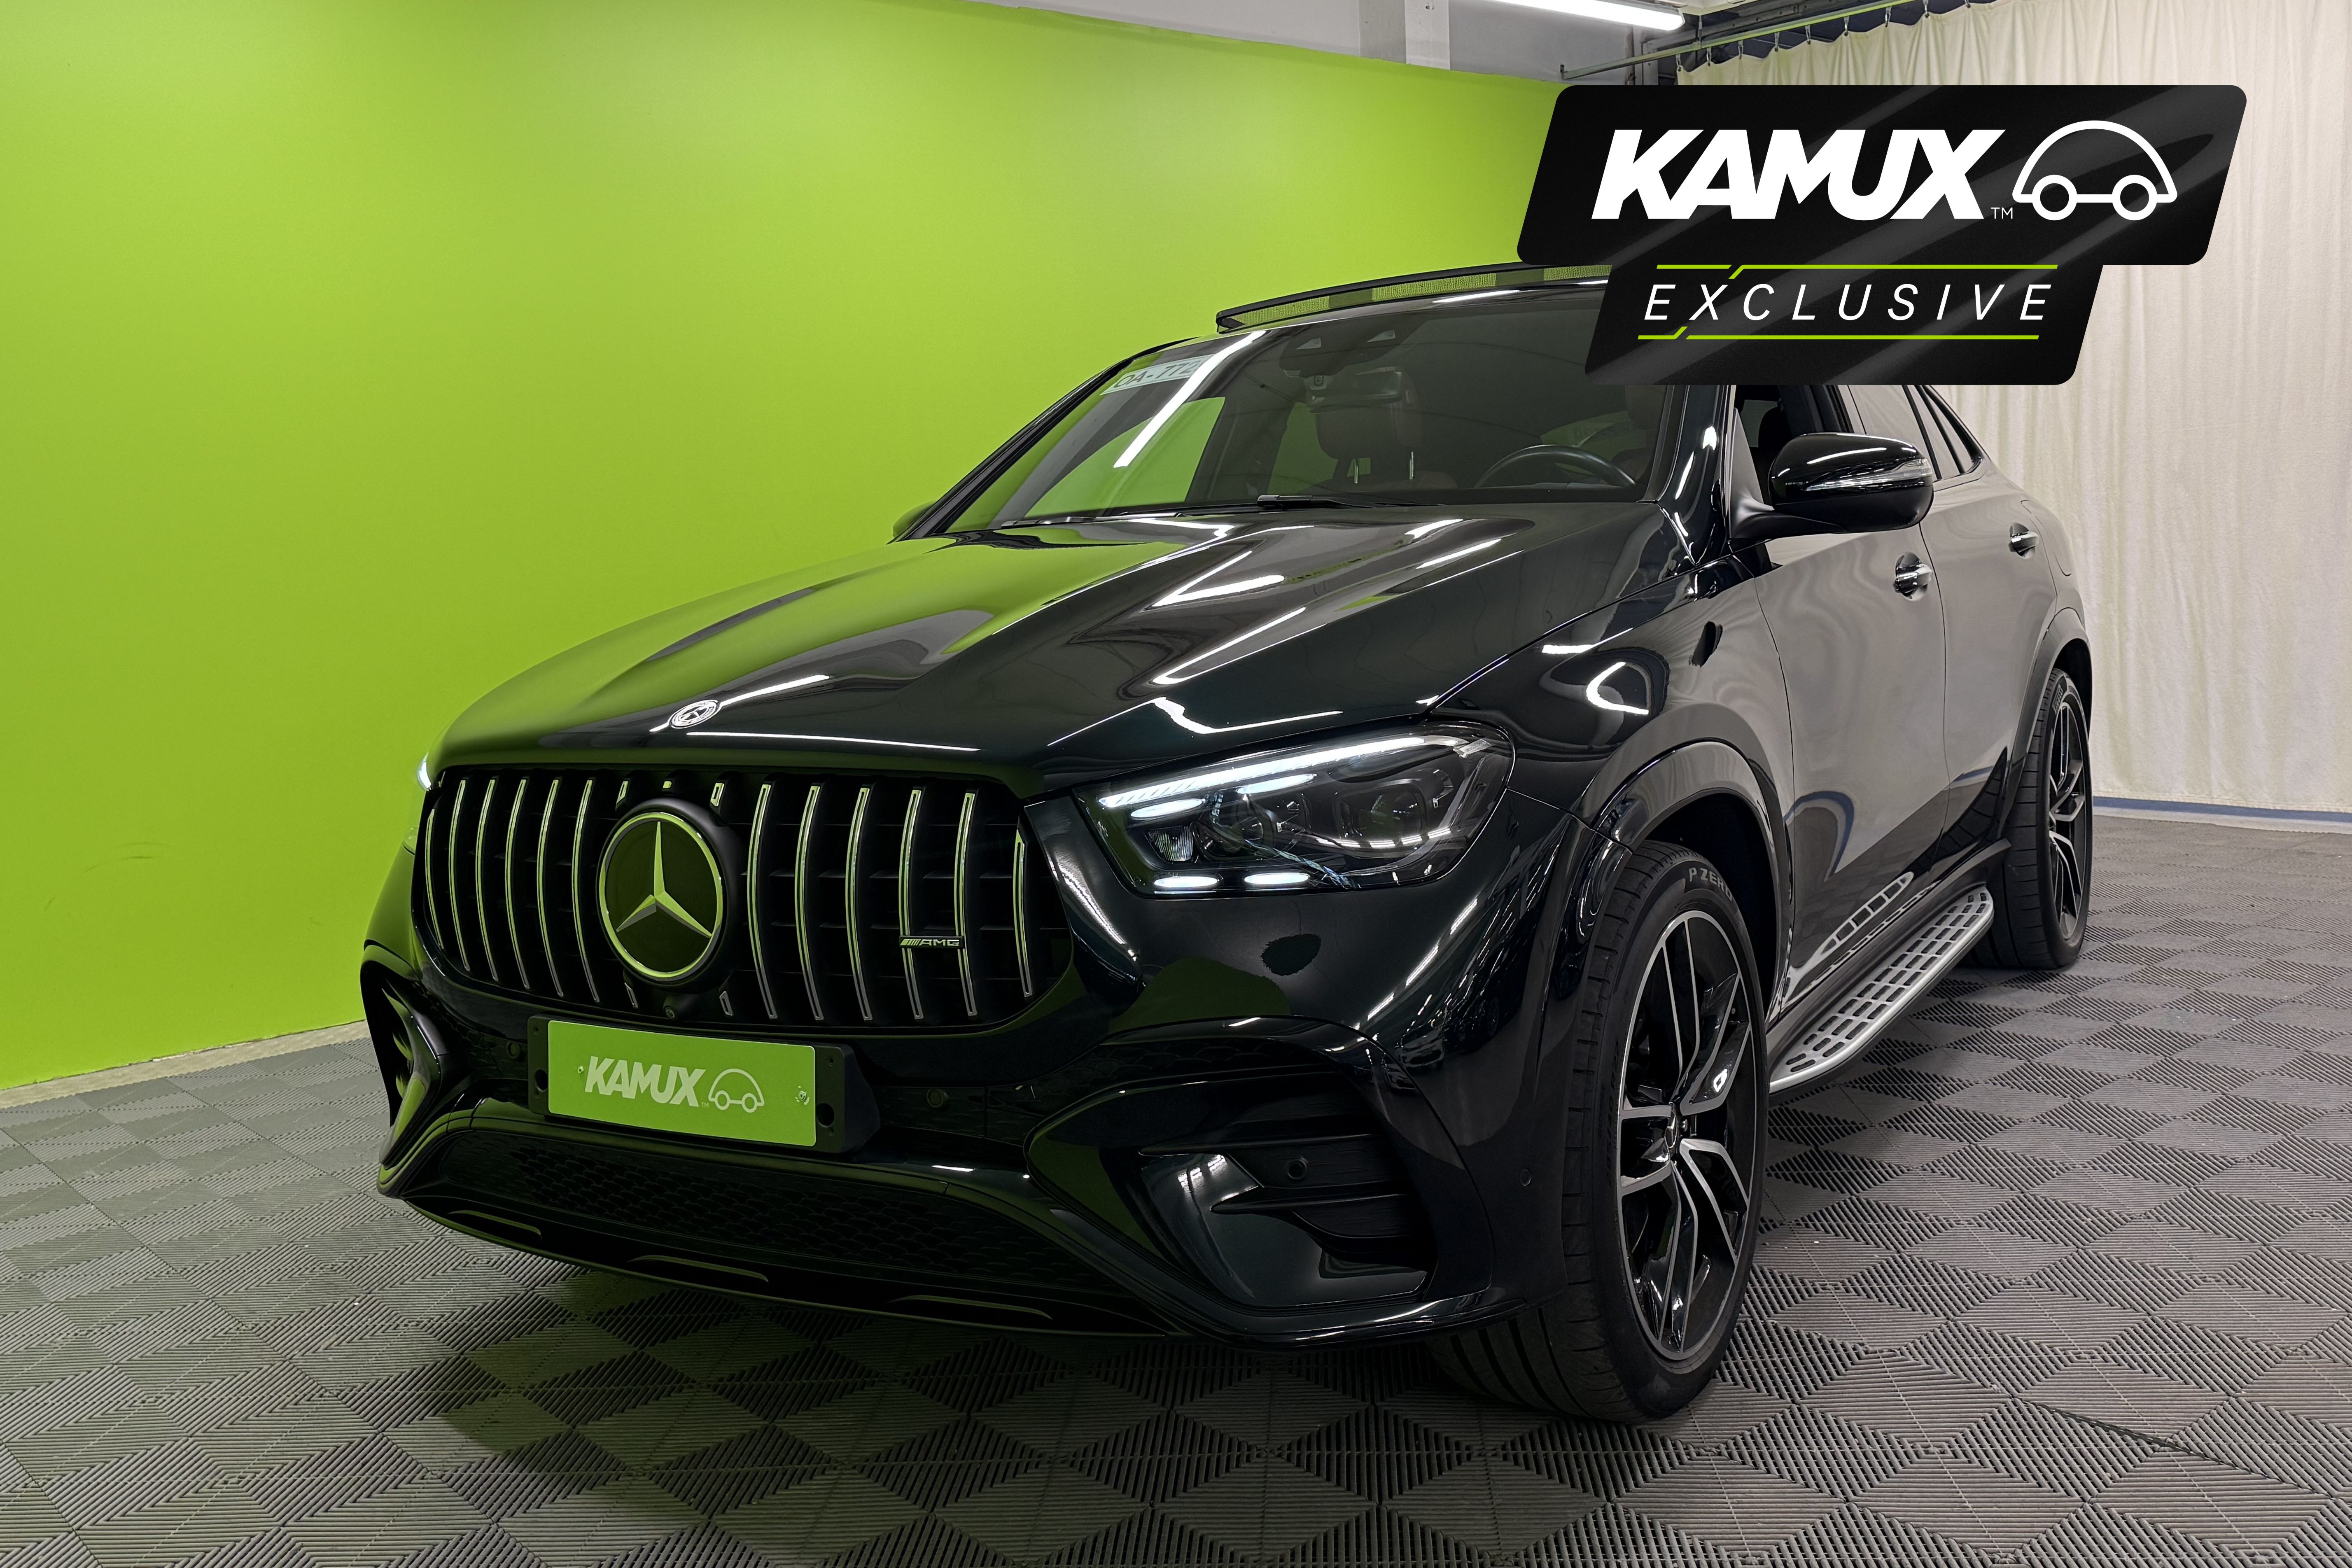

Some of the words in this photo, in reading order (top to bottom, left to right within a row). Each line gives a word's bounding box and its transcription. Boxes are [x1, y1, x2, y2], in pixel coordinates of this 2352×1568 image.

[1689, 867, 1697, 882] P
[1700, 868, 1734, 901] ZERO
[585, 1056, 706, 1107] KAMUX
